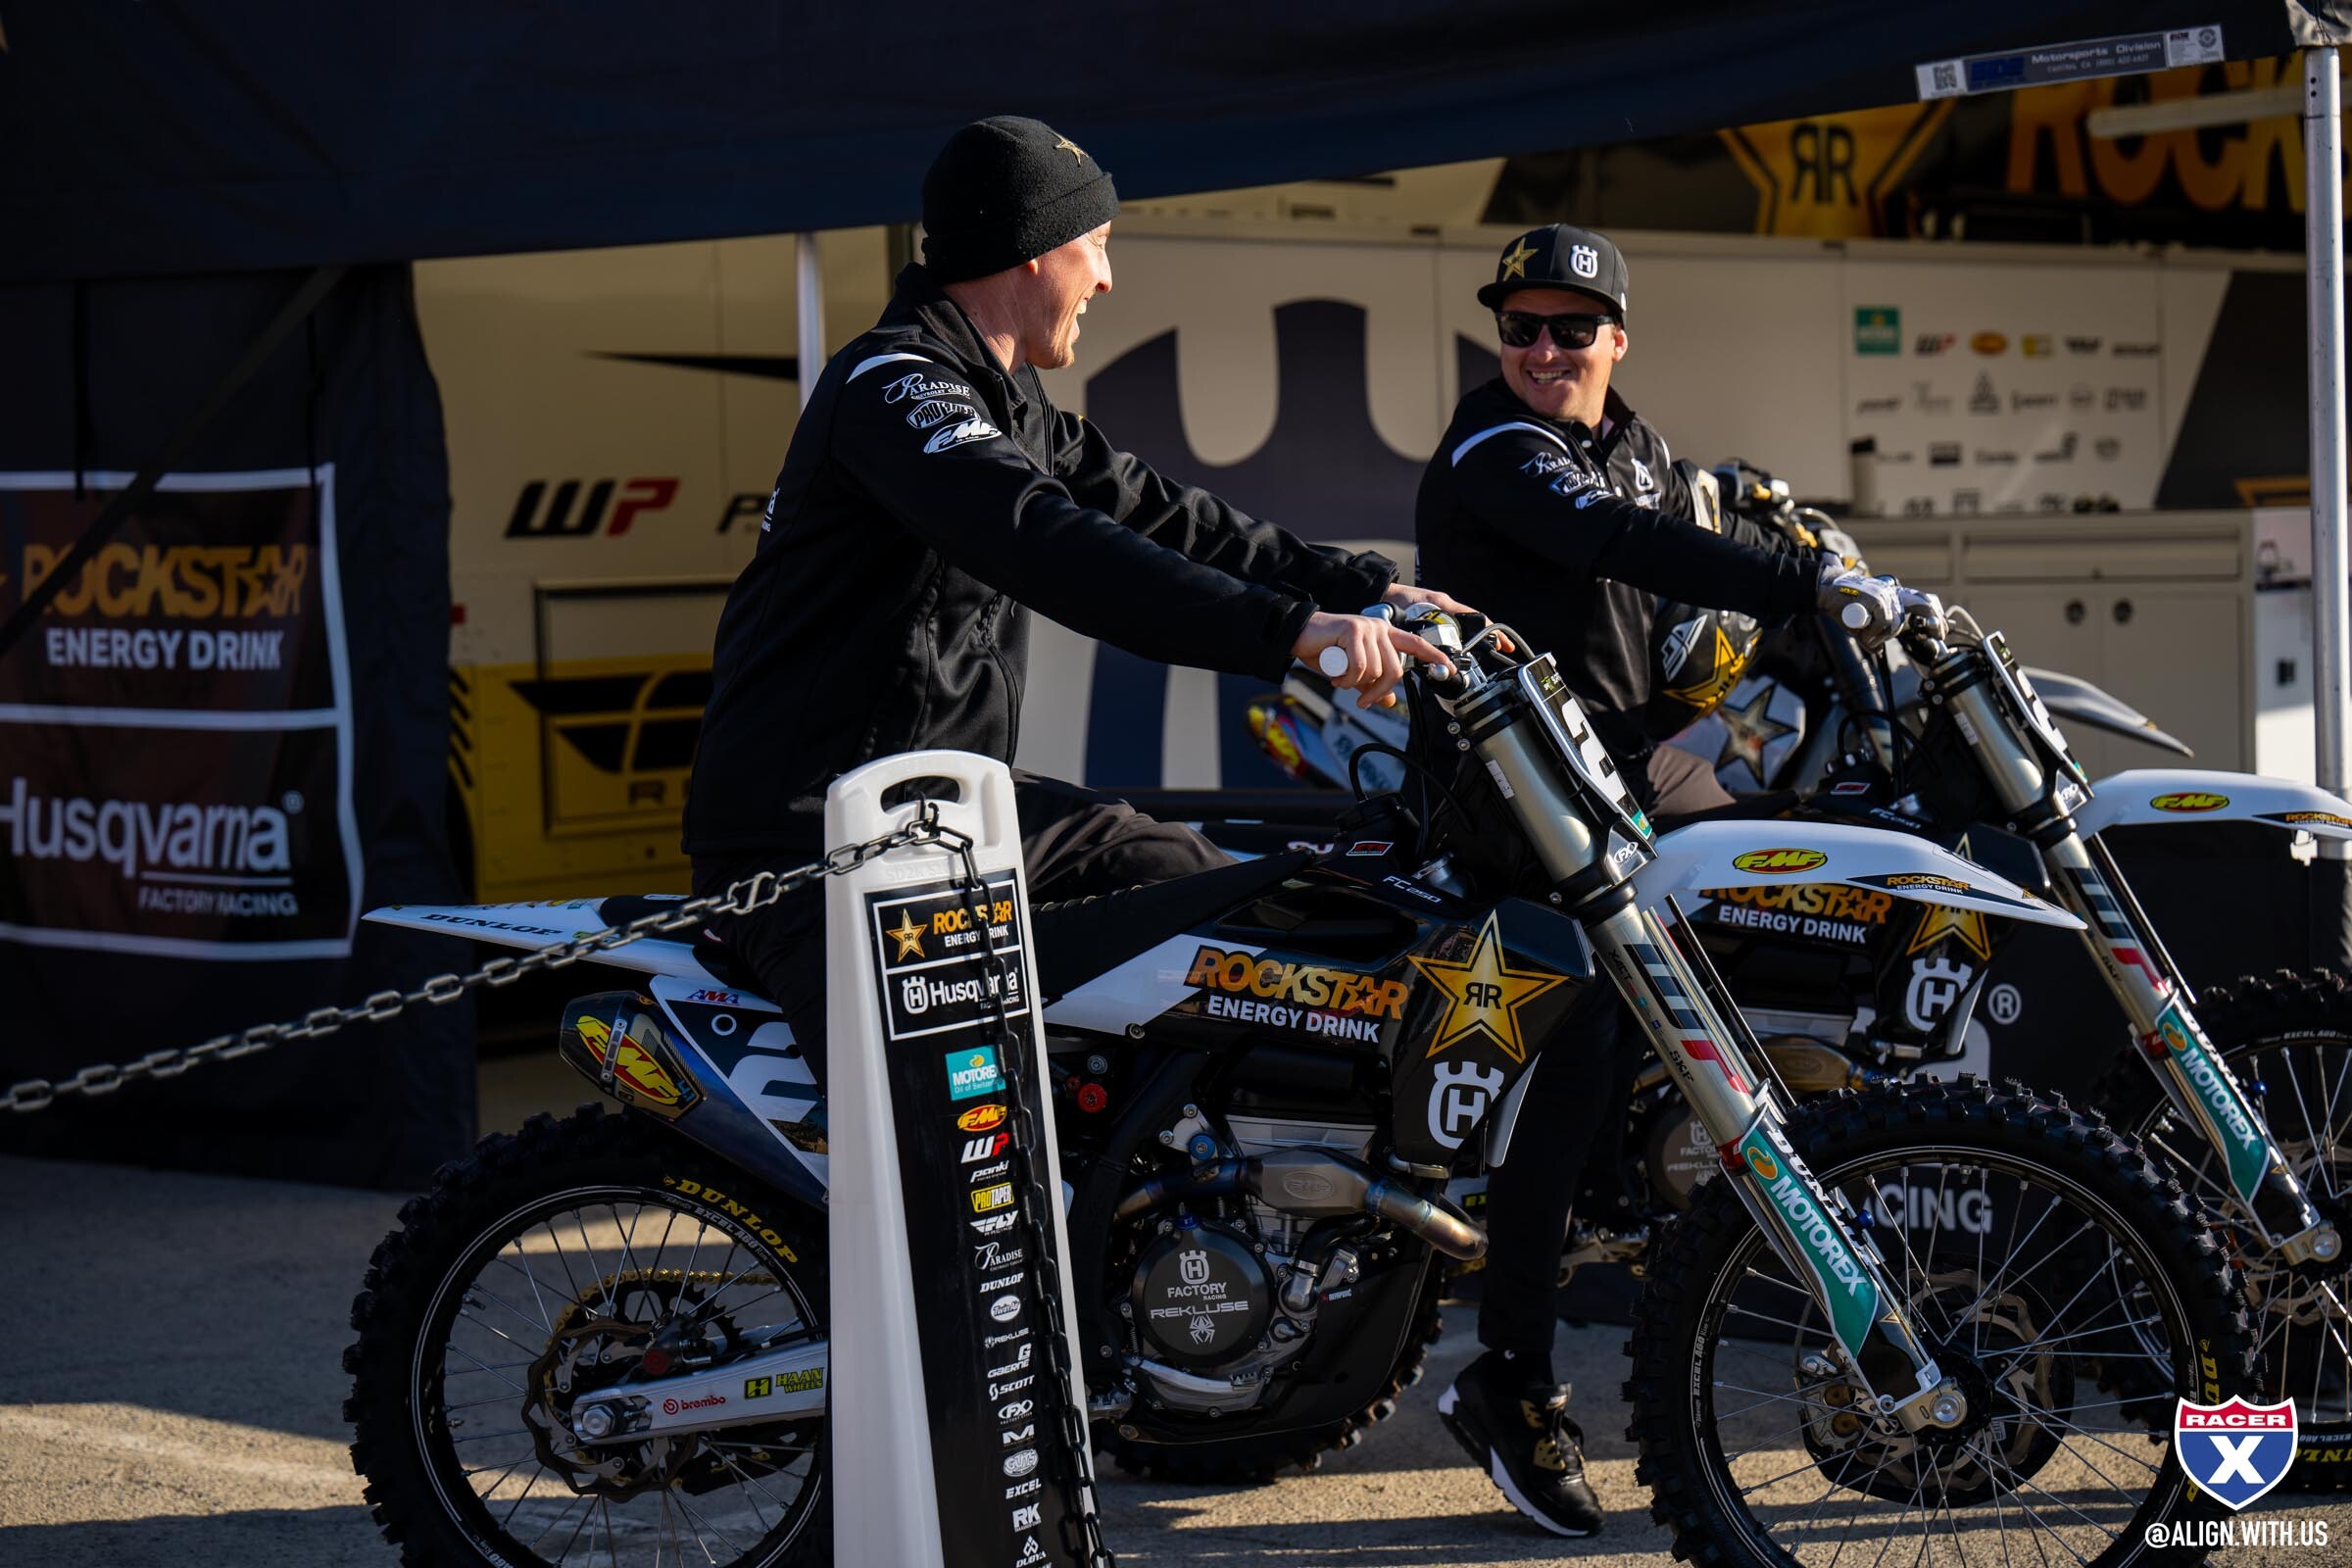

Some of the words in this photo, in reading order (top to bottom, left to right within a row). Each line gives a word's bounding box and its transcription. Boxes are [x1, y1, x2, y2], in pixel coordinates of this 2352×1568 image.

[2032, 47, 2109, 65] Motorsports
[2115, 40, 2163, 56] Division
[881, 373, 970, 405] PARADISE
[506, 478, 679, 538] WP
[22, 542, 309, 619] ROCKSTAR
[45, 628, 184, 670] ENERGY
[188, 628, 284, 670] DRINK
[2152, 793, 2229, 811] FMF
[1734, 850, 1827, 871] FMF
[1886, 875, 1970, 891] ROCKSTAR
[1896, 883, 1931, 892] ENERGY
[1932, 885, 1964, 894] DRINK
[138, 885, 214, 912] FACTORY
[216, 888, 299, 917] RACING
[420, 913, 564, 935] DUNLOP
[933, 900, 1013, 936] ROCSAR
[1718, 904, 1811, 938] ENERGY
[1812, 918, 1868, 944] DRINK
[944, 930, 981, 948] ENERGY
[988, 925, 1009, 940] RINK
[929, 971, 1018, 1007] Husqvara
[1185, 944, 1410, 1019] ROCKSTAR
[687, 989, 740, 1004] AMA
[1207, 994, 1304, 1030] ENERGY
[1305, 1009, 1381, 1044] DRINK
[1669, 1051, 1693, 1082] SKF
[965, 1082, 972, 1092] of
[2180, 1047, 2259, 1151] MOTOREX
[957, 1106, 1007, 1130] FMF
[961, 1132, 1009, 1163] WP
[675, 1178, 800, 1263] DUNLOP
[693, 1205, 739, 1238] EXCEL
[735, 1229, 760, 1253] A60
[970, 1210, 1018, 1233] FLY
[1770, 1175, 1868, 1297] MOTOREX
[974, 1242, 1023, 1270] PARADISE
[980, 1272, 1024, 1293] DUNLOP
[1167, 1282, 1227, 1298] FACTORY
[1151, 1300, 1250, 1320] REKLUSE
[994, 1327, 1029, 1344] REKLUSE
[775, 1367, 823, 1387] HAAN
[785, 1380, 823, 1393] WHEELS
[1000, 1374, 1035, 1395] SCOTT
[1692, 1355, 1702, 1396] EXCEL
[681, 1396, 726, 1409] brembo
[1005, 1478, 1042, 1499] EXCEL
[1012, 1503, 1041, 1530] RK
[1015, 1550, 1047, 1568] DUBYA
